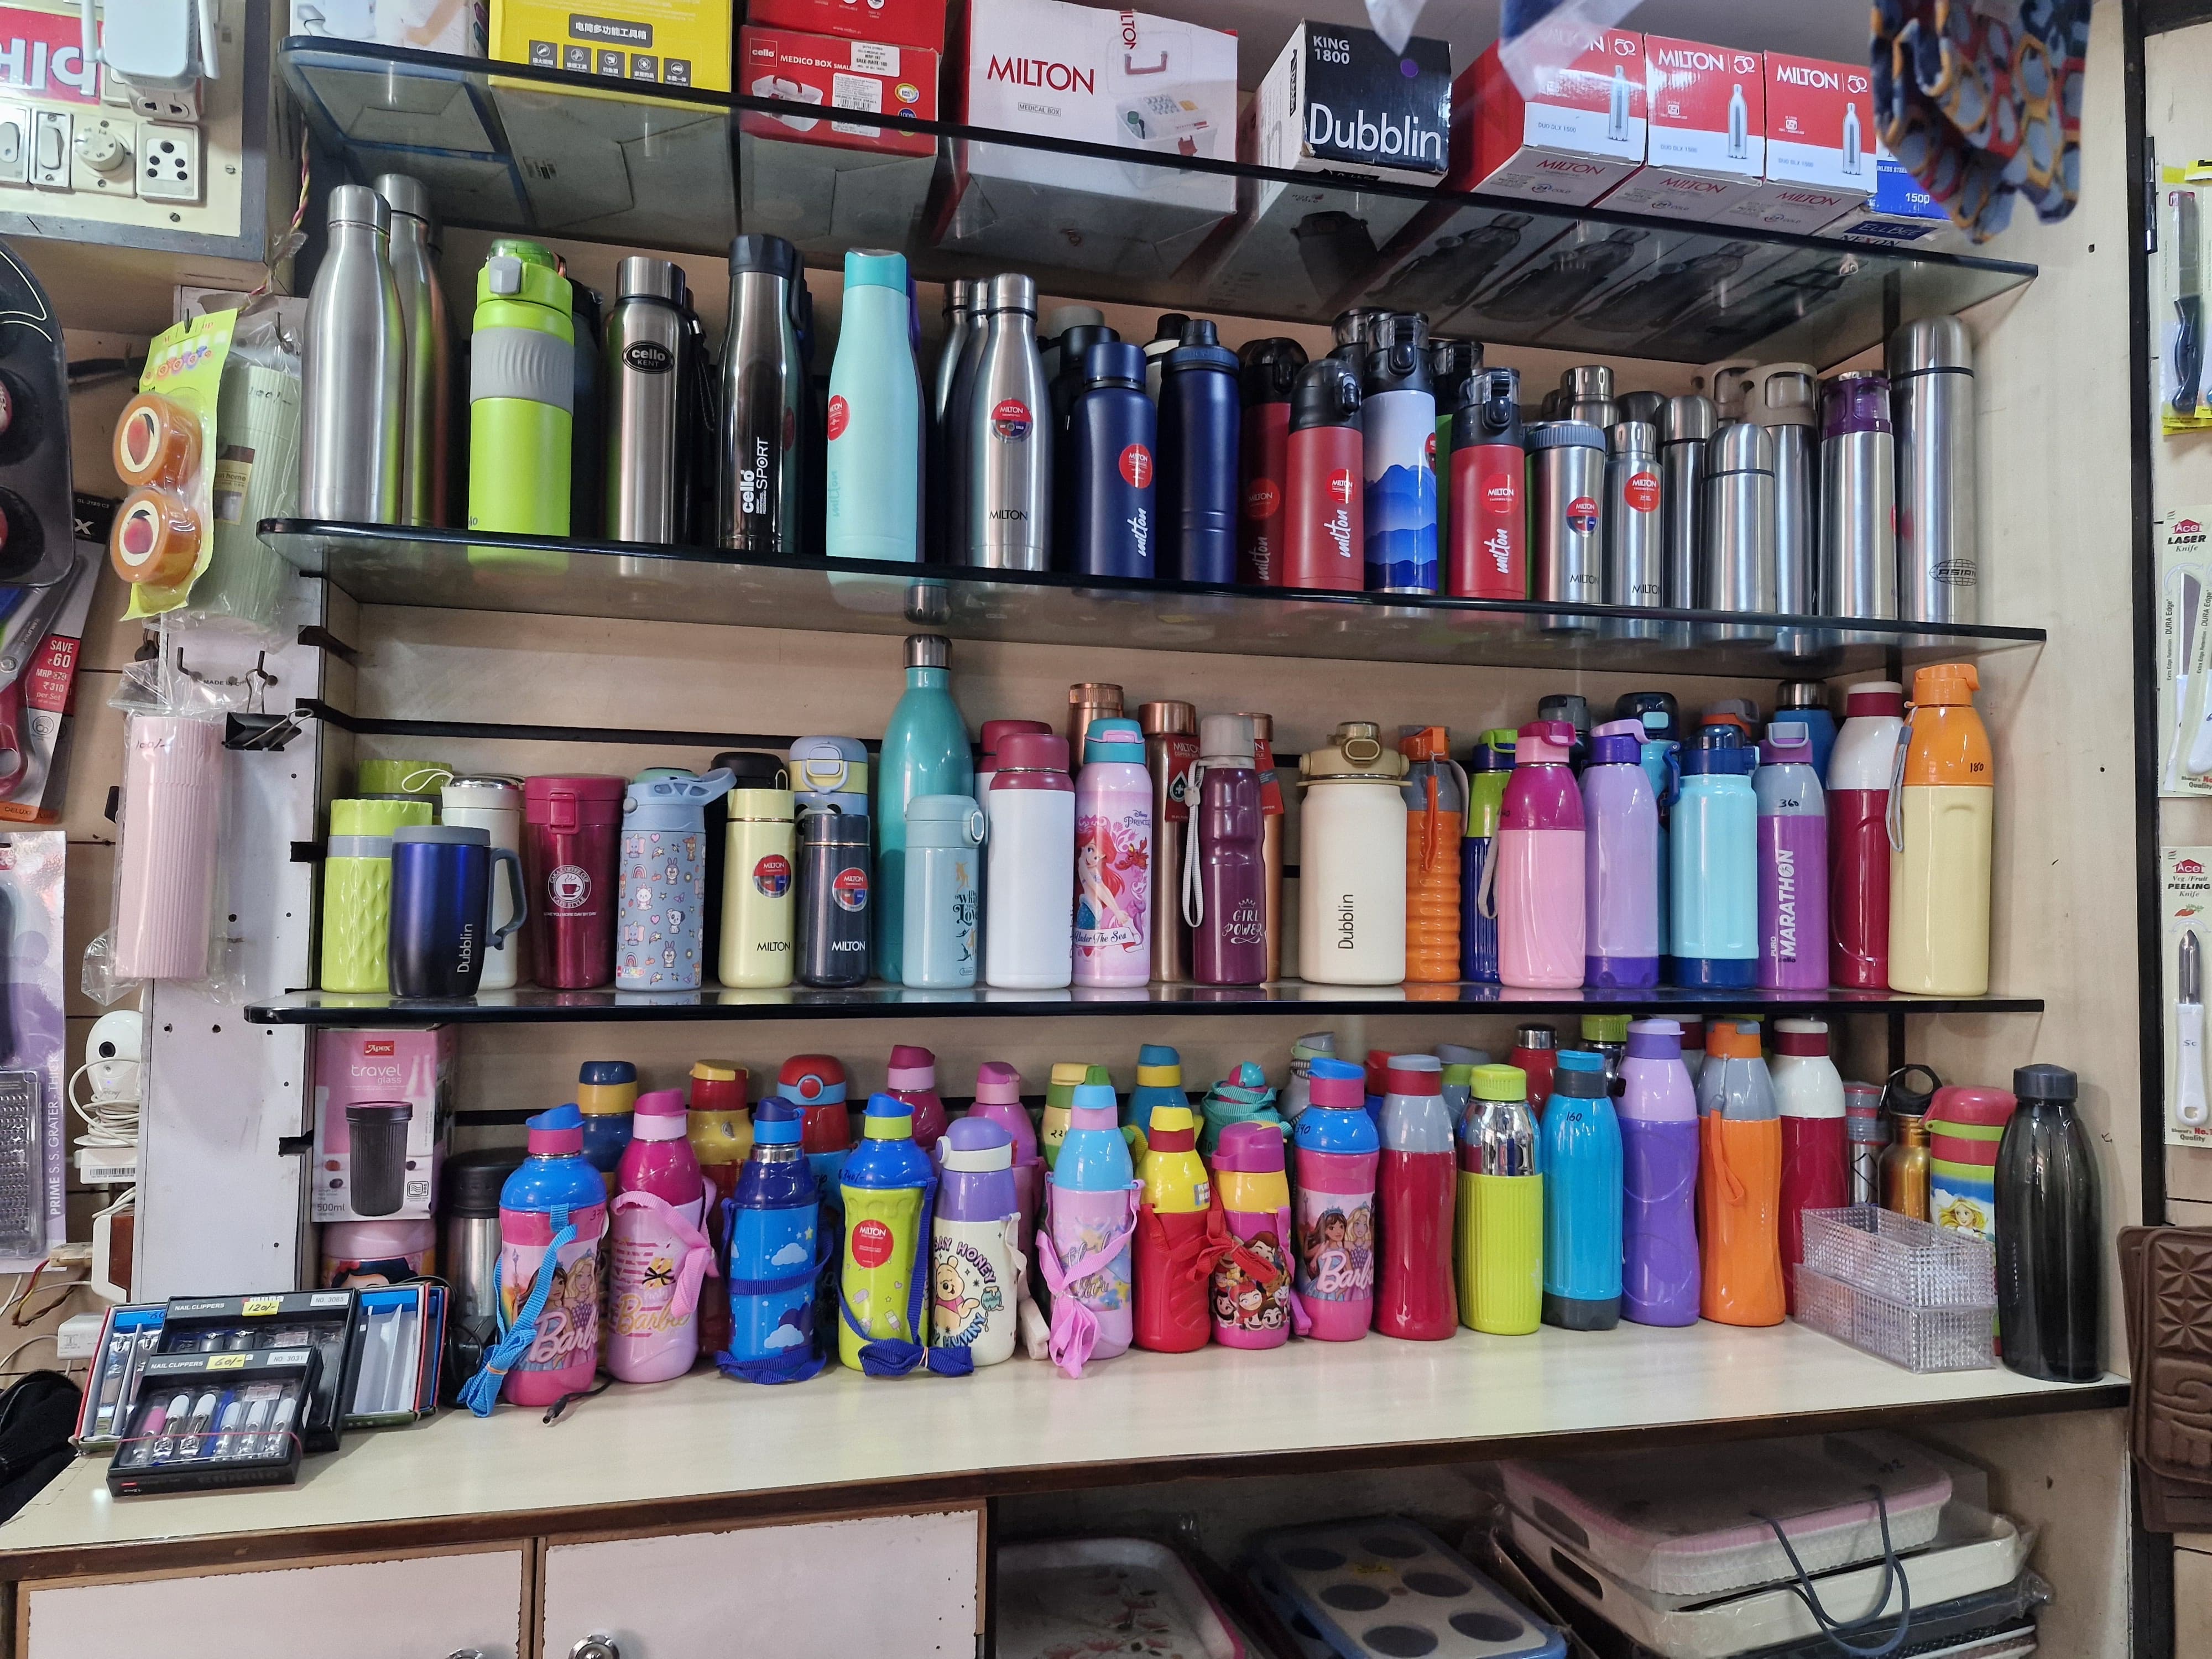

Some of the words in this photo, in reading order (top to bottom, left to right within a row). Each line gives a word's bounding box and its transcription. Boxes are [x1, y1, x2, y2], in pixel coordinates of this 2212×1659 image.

[1312, 35, 1350, 51] KING
[752, 48, 775, 58] cello
[1314, 49, 1350, 65] 1800
[780, 55, 813, 66] MEDICO
[815, 59, 832, 68] BOX
[1658, 51, 1725, 73] MILTON
[987, 54, 1095, 96] MILTON
[1776, 64, 1839, 90] MILTON
[1019, 103, 1046, 114] MEDICAL
[1047, 108, 1061, 116] BOX
[1309, 102, 1442, 160] Dubblin
[1536, 159, 1606, 175] MILTON
[1660, 177, 1728, 195] MILTON
[1776, 191, 1842, 206] MILTON
[1905, 192, 1931, 205] 1500
[632, 348, 666, 361] cello
[637, 359, 659, 367] KENT
[756, 436, 769, 489] SPORT
[1129, 452, 1148, 462] MILTON
[1332, 479, 1353, 488] MILTON
[1631, 478, 1657, 488] MILTON
[740, 469, 755, 513] cello
[1249, 492, 1273, 501] MILTON
[1488, 488, 1514, 497] MILTON
[989, 509, 1028, 521] MILTON
[1127, 507, 1149, 557] milton
[1323, 509, 1352, 559] milton
[2167, 535, 2207, 545] LASER
[1483, 528, 1511, 574] milton
[1248, 536, 1271, 581] milton
[2201, 608, 2210, 627] DURA
[50, 640, 74, 654] SAVE
[35, 668, 53, 679] MRP
[1969, 760, 1985, 773] 180
[1778, 799, 1801, 808] 360
[1777, 849, 1797, 957] MARATHON
[1232, 910, 1259, 922] GIRL
[1338, 894, 1354, 950] Dubblin
[1222, 922, 1264, 937] POWER
[1074, 930, 1093, 943] Under
[1093, 932, 1109, 944] The
[1110, 930, 1126, 942] Sea
[457, 922, 473, 973] Dubblin
[757, 942, 791, 952] MILTON
[831, 941, 865, 952] MILTON
[364, 1044, 392, 1053] Apex
[47, 1052, 60, 1093] THICK
[351, 1063, 402, 1077] travel
[377, 1076, 402, 1086] glass
[1566, 1111, 1583, 1123] 160
[48, 1102, 60, 1149] GRATER
[2180, 1133, 2206, 1142] Quality
[49, 1178, 61, 1215] PRIME
[317, 1203, 346, 1212] 500ml
[859, 1225, 887, 1237] MILTON
[956, 1241, 997, 1284] HONEY
[191, 1302, 225, 1311] CLIPPERS
[247, 1302, 276, 1313] 120/-
[168, 1360, 204, 1368] CLIPPERS
[286, 1354, 303, 1363] 3031
